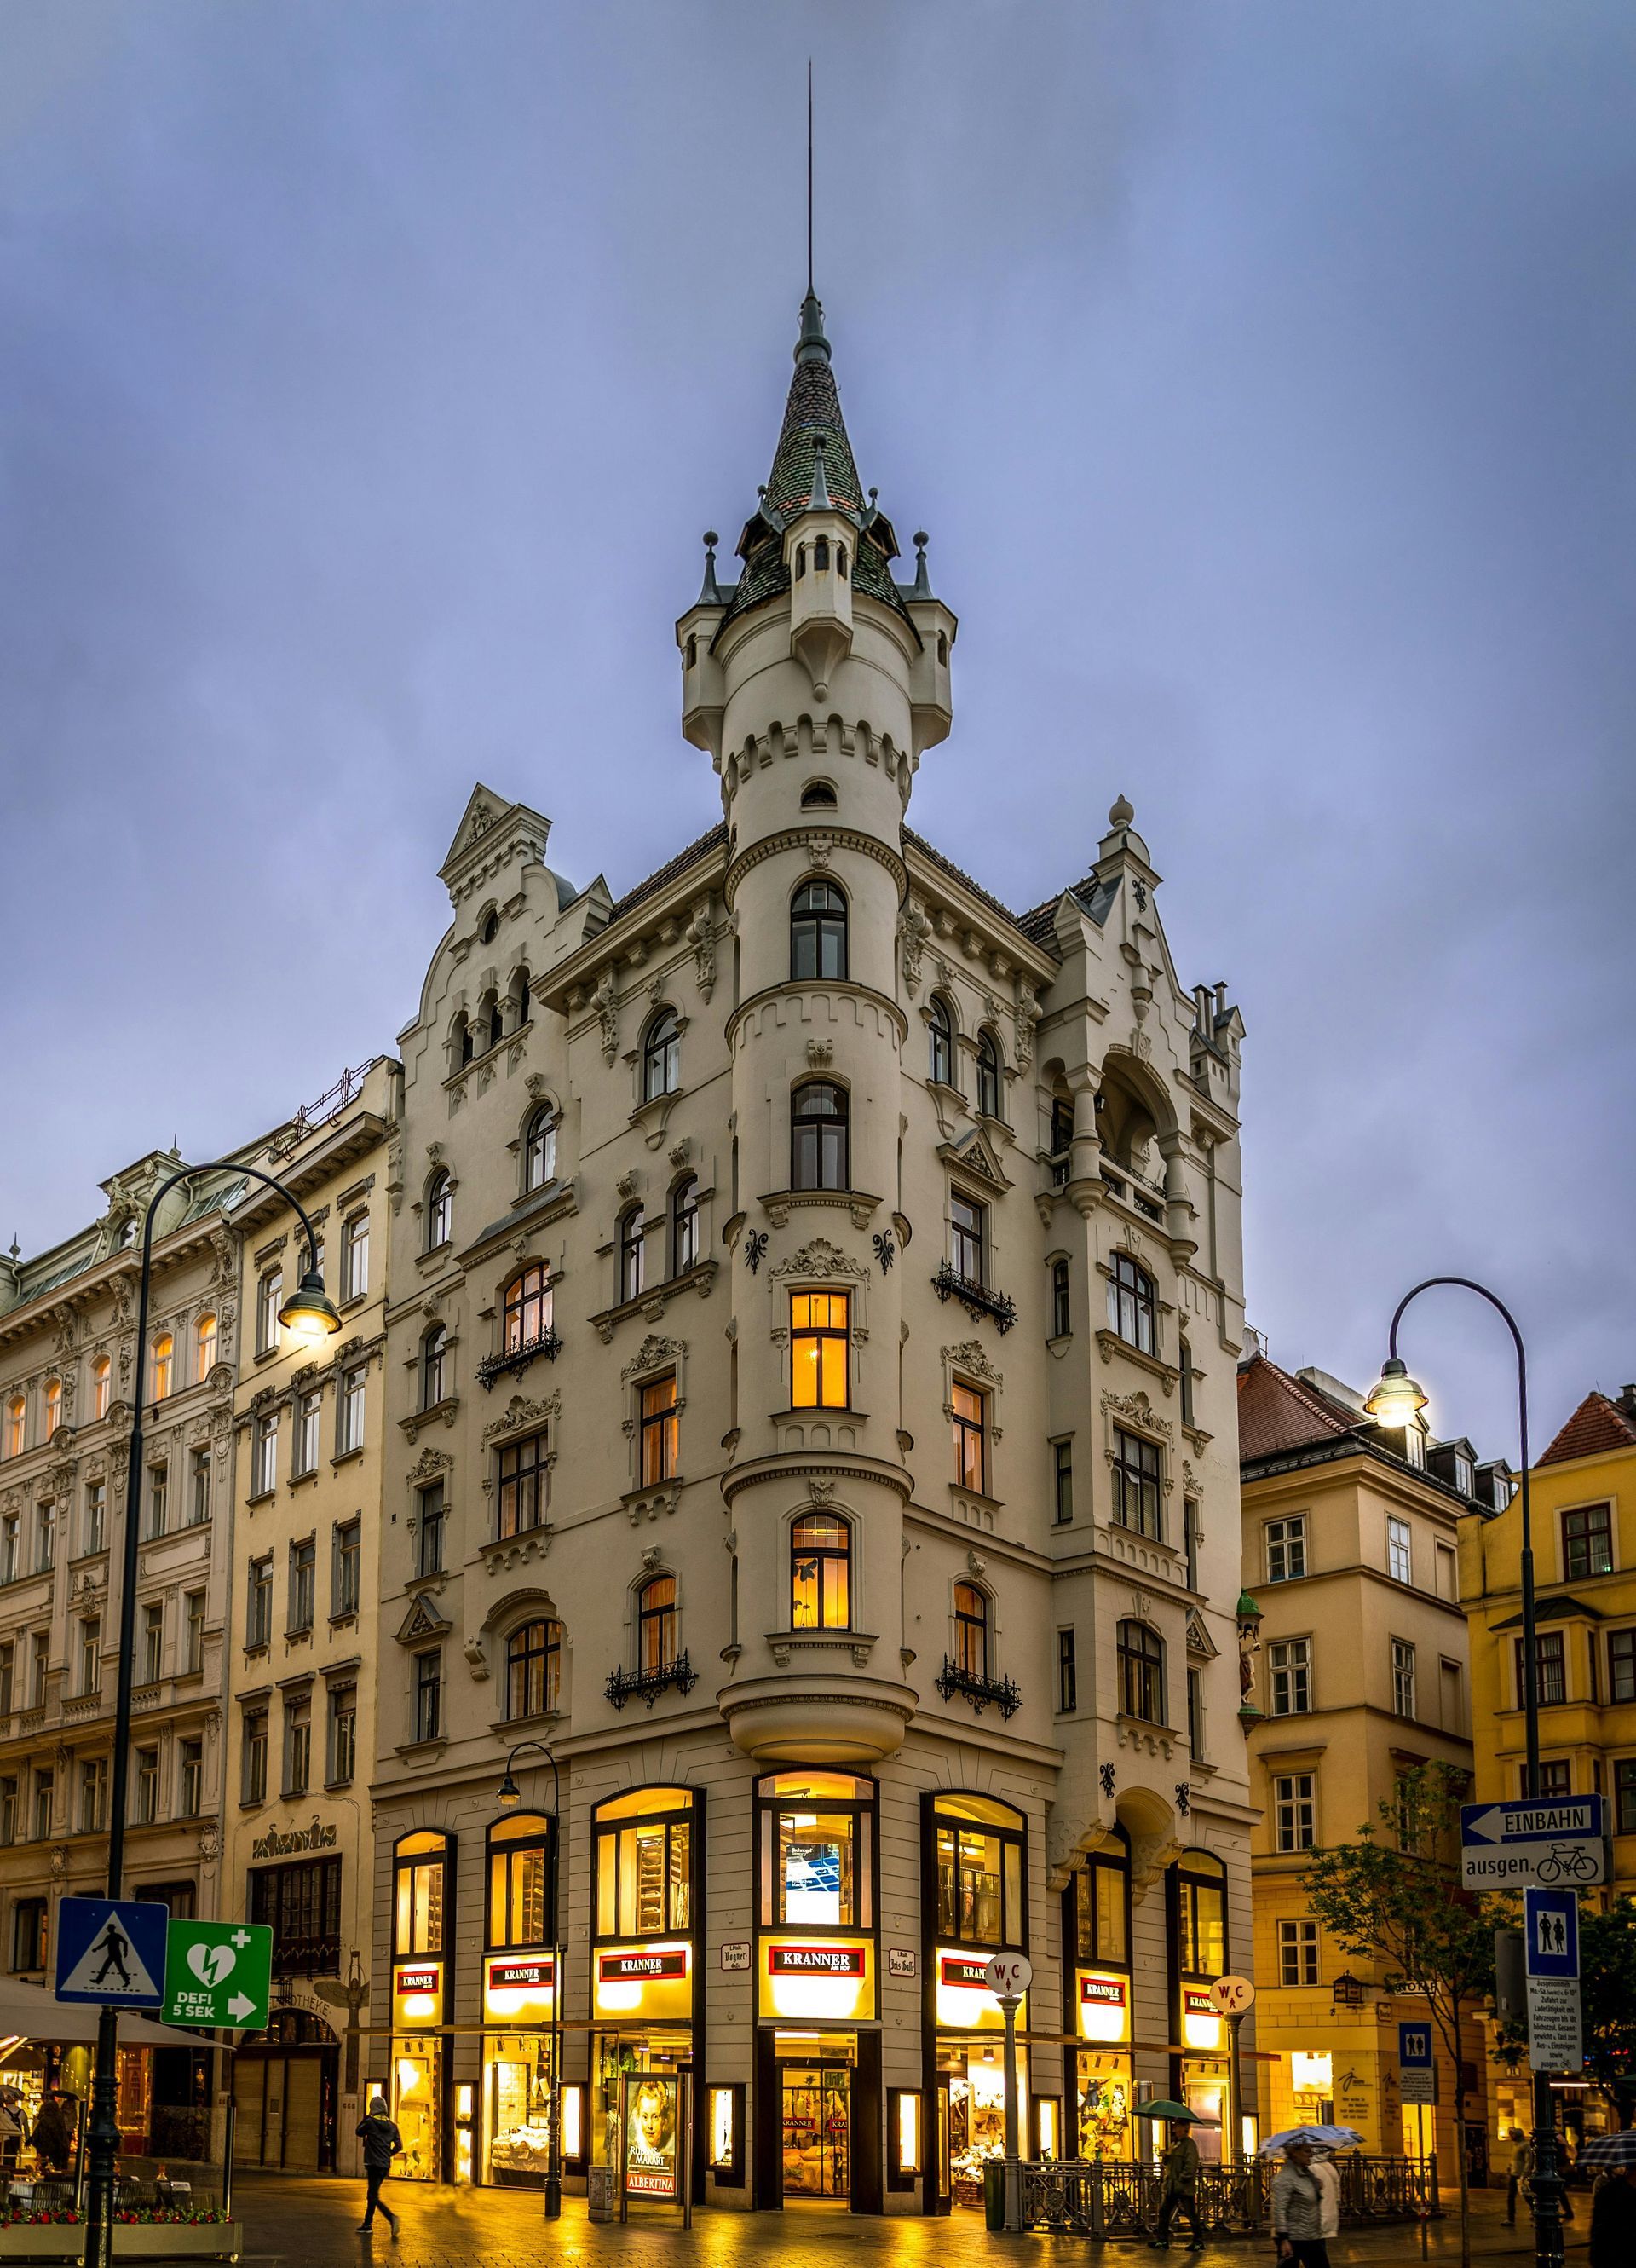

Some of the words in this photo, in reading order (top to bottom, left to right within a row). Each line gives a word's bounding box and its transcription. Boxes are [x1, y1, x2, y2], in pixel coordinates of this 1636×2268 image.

[1505, 1809, 1584, 1832] EINBAHN
[1466, 1858, 1535, 1878] ausgen.
[621, 1959, 662, 1971] KRANNER
[783, 1953, 850, 1965] KRANNER
[504, 1968, 539, 1980] KRANNER
[963, 1965, 986, 1979] KRAN
[403, 1975, 432, 1986] KRANNER
[1087, 1983, 1119, 1997] KRANNER
[177, 1992, 212, 2005] DEFI
[173, 2005, 181, 2016] 5
[186, 2005, 215, 2018] SEK
[636, 2155, 665, 2166] MAKART
[629, 2176, 673, 2190] ALBERTINA
